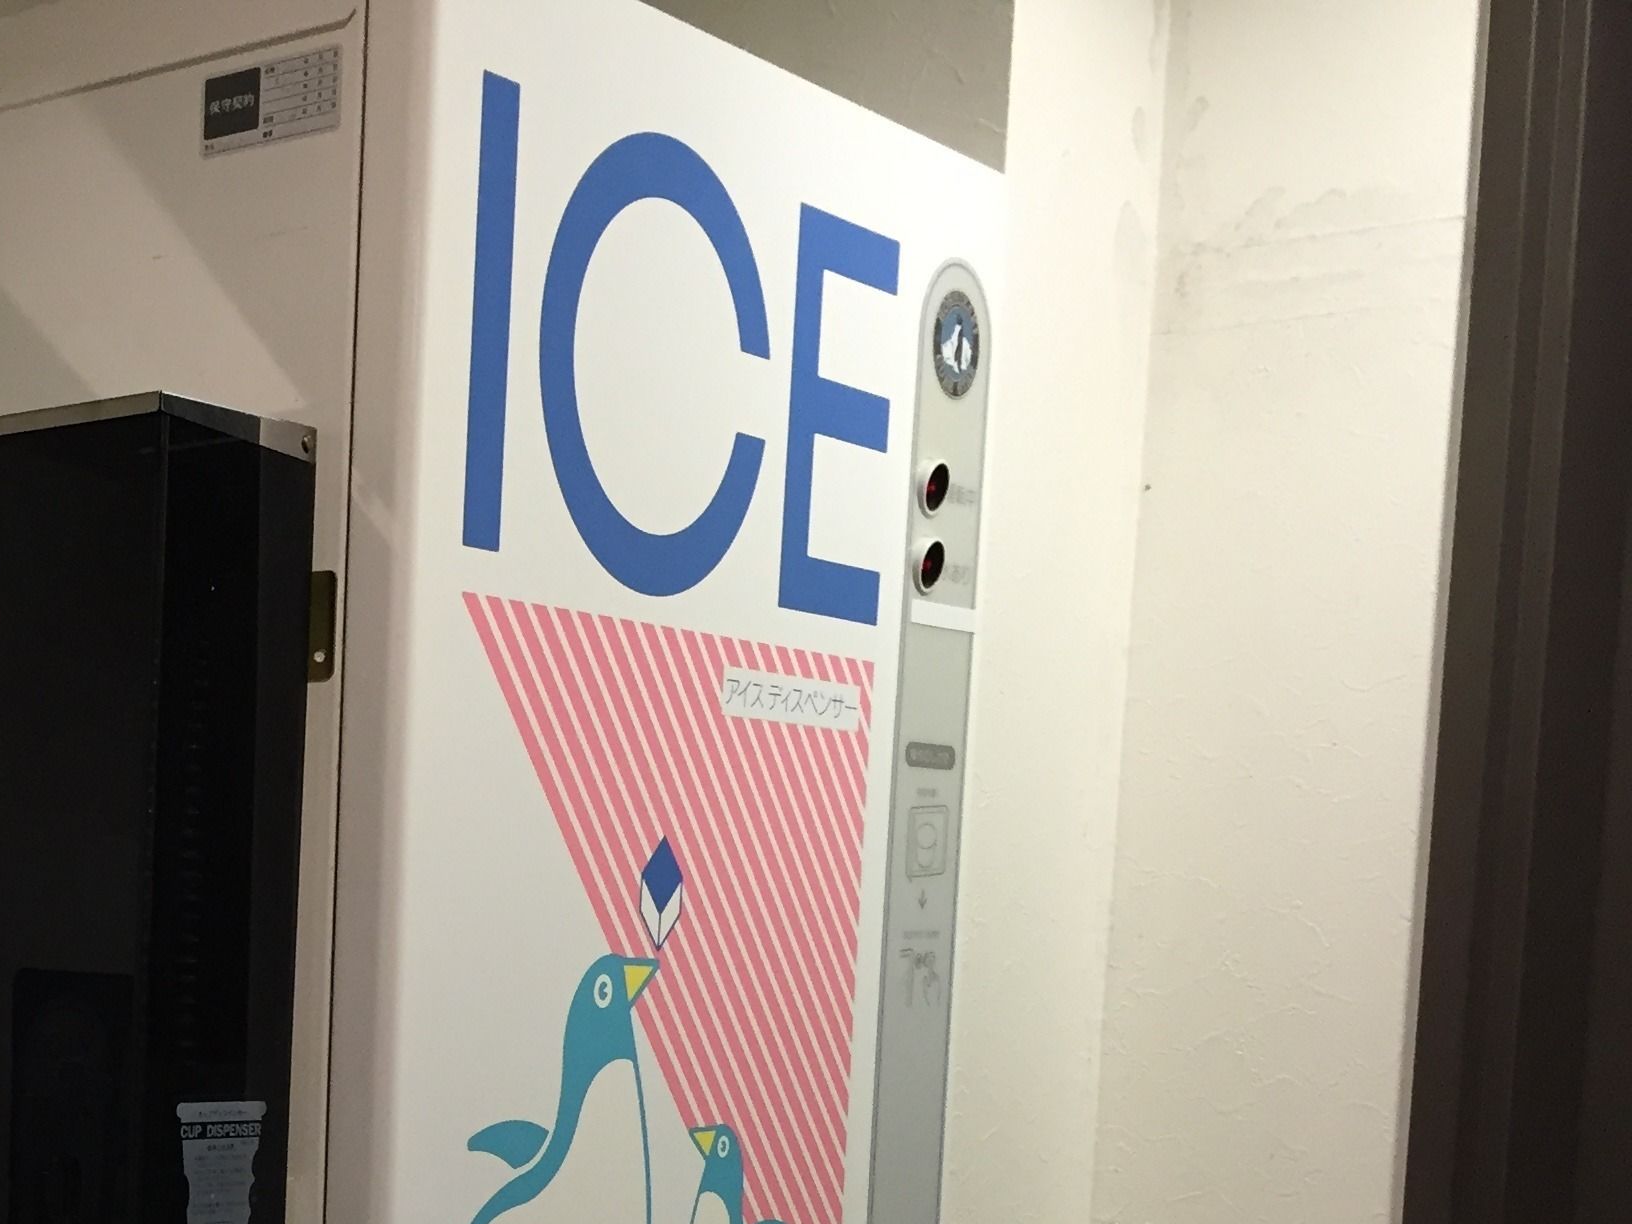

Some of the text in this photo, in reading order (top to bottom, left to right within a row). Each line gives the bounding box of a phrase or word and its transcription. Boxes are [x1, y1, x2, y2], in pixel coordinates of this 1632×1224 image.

[462, 69, 900, 626] ICE
[180, 1122, 262, 1139] CUP DISPENSER
